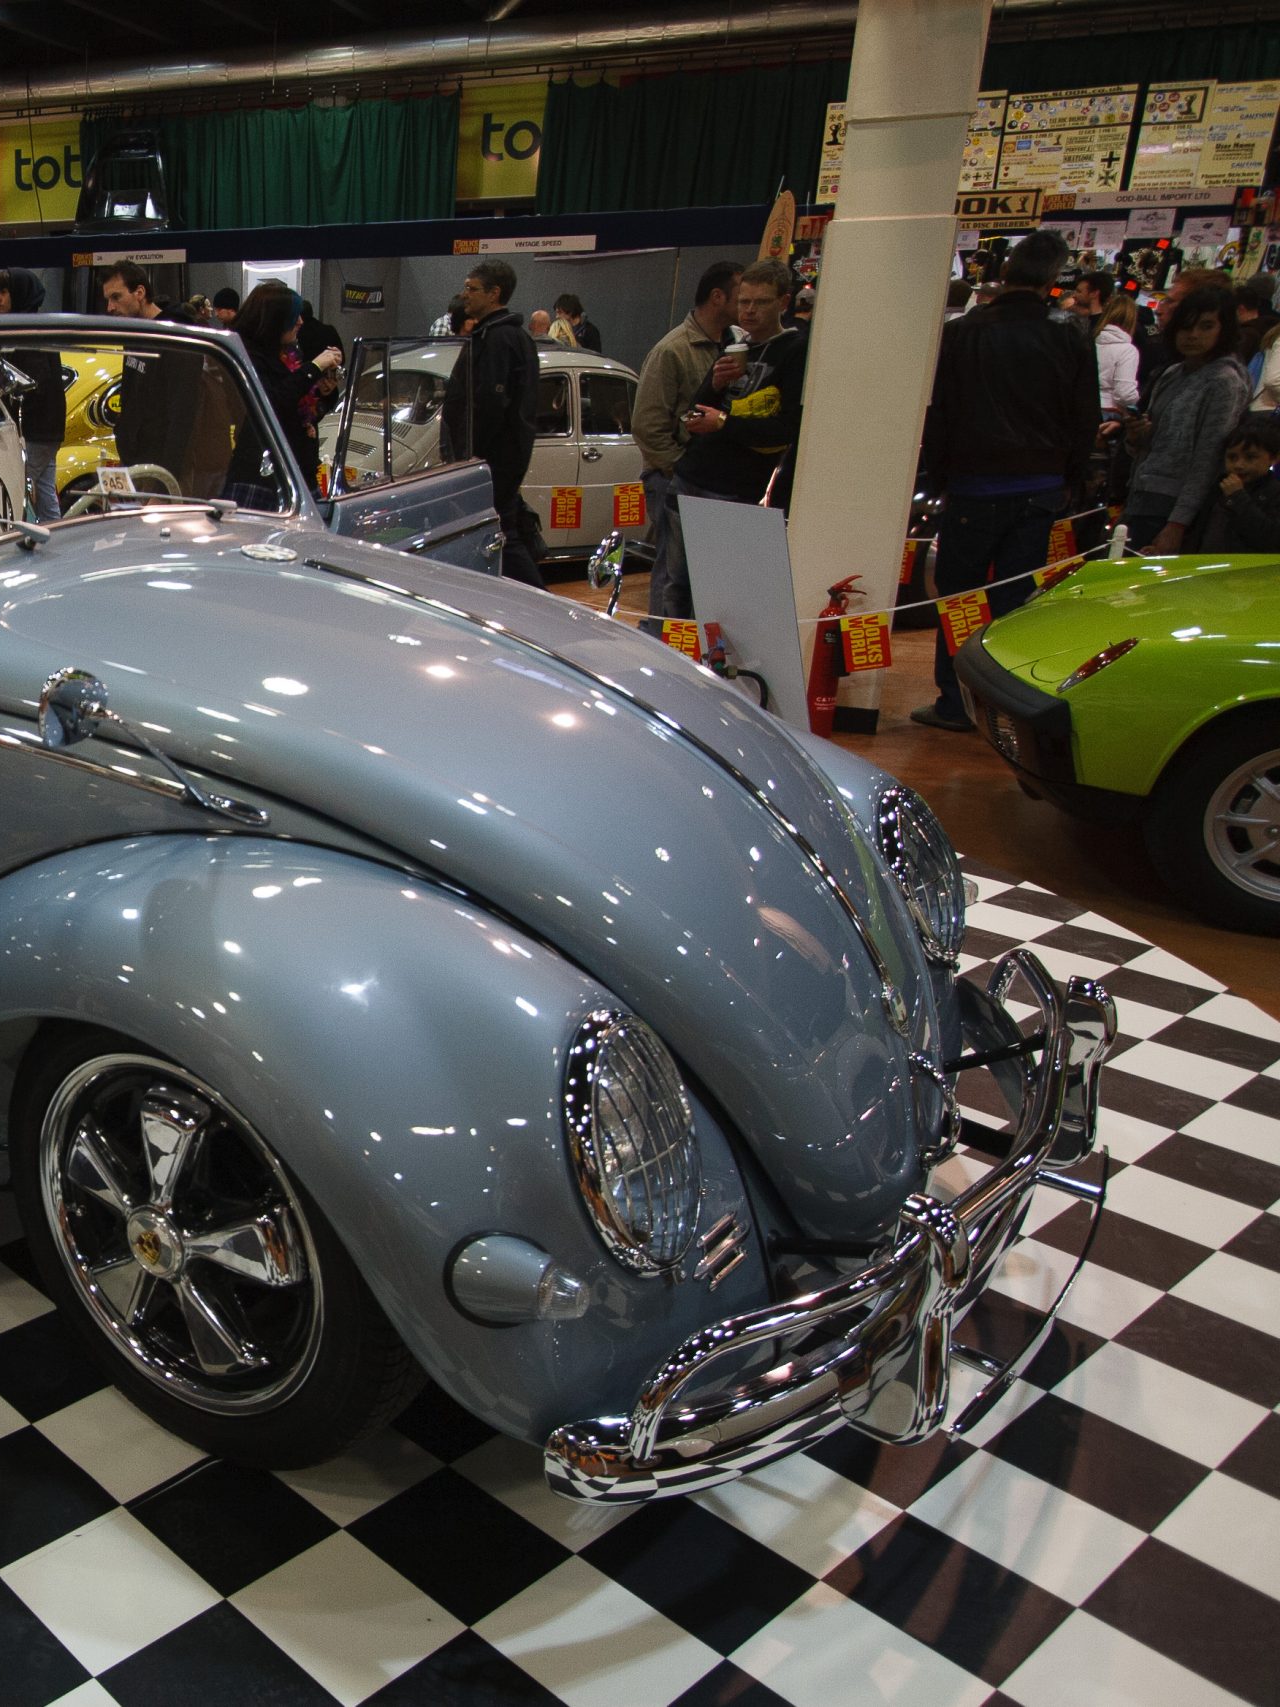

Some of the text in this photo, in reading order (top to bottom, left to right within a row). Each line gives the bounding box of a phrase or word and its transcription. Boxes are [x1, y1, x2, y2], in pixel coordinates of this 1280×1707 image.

[1160, 193, 1192, 201] IMPORT
[1195, 192, 1210, 200] LTD
[556, 488, 566, 524] WORLD
[566, 489, 577, 524] VOLKS
[618, 486, 629, 522] WORLD
[629, 485, 640, 521] VOLKS
[848, 616, 868, 665] WORLD
[863, 615, 883, 664] VOLKS
